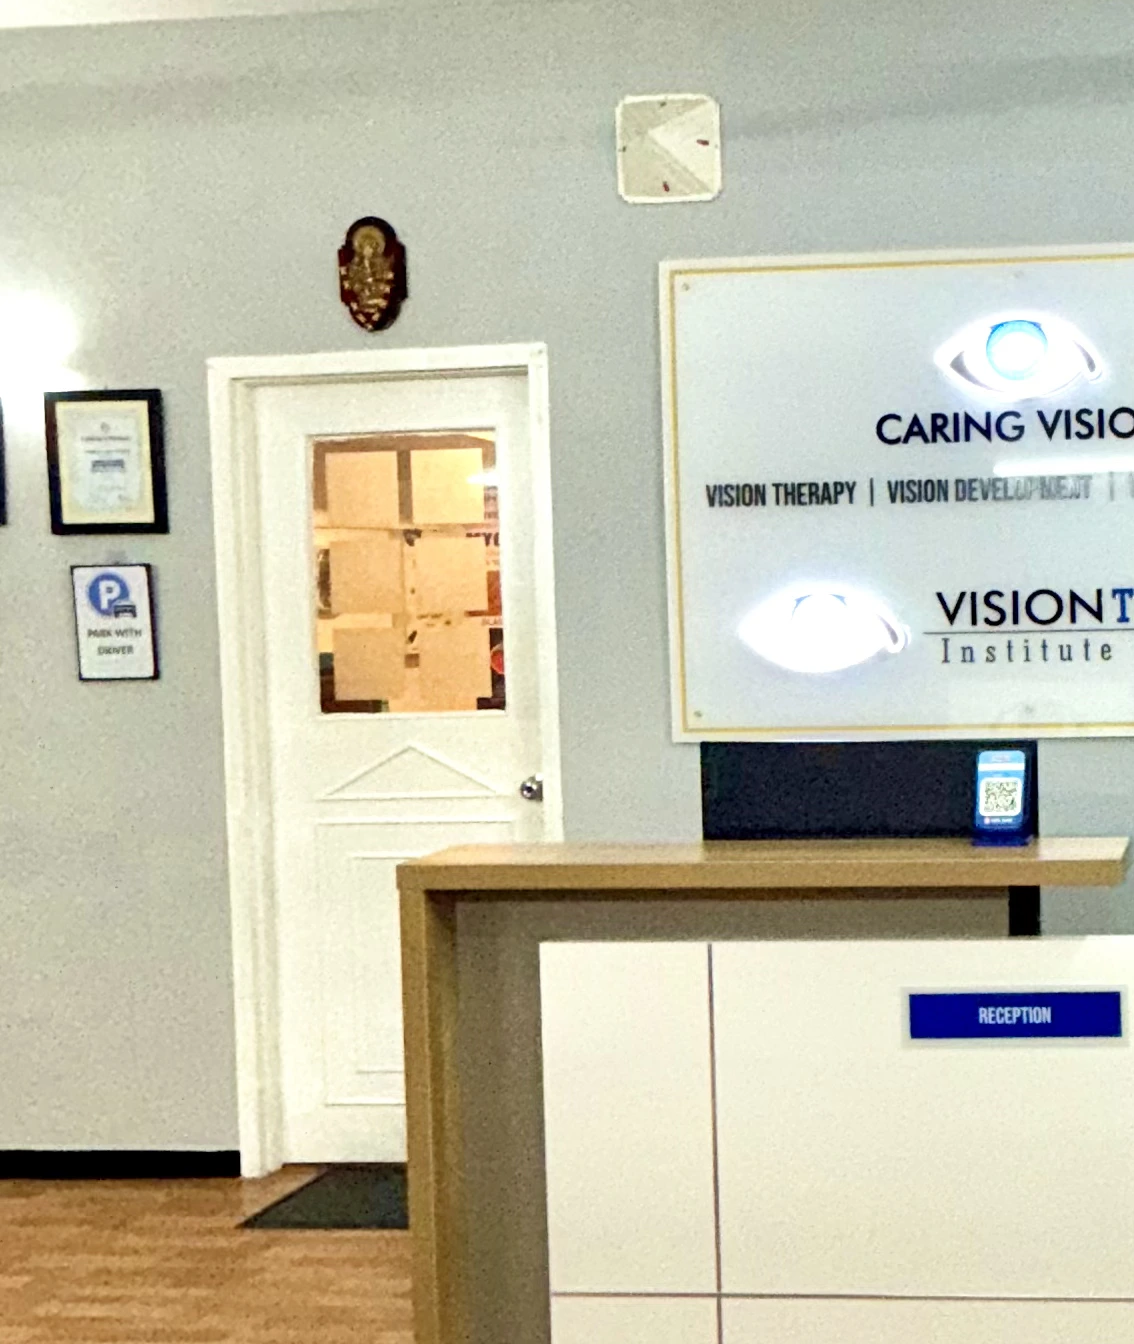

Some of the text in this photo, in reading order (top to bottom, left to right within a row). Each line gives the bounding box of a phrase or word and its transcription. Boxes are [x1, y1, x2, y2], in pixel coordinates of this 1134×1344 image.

[875, 410, 1026, 446] CARING
[705, 483, 767, 507] VISION
[772, 481, 857, 506] THERAPY
[887, 478, 950, 504] VISION
[936, 588, 1104, 627] VISION
[941, 637, 1112, 664] Institute
[978, 1006, 1052, 1025] RECEPTION
